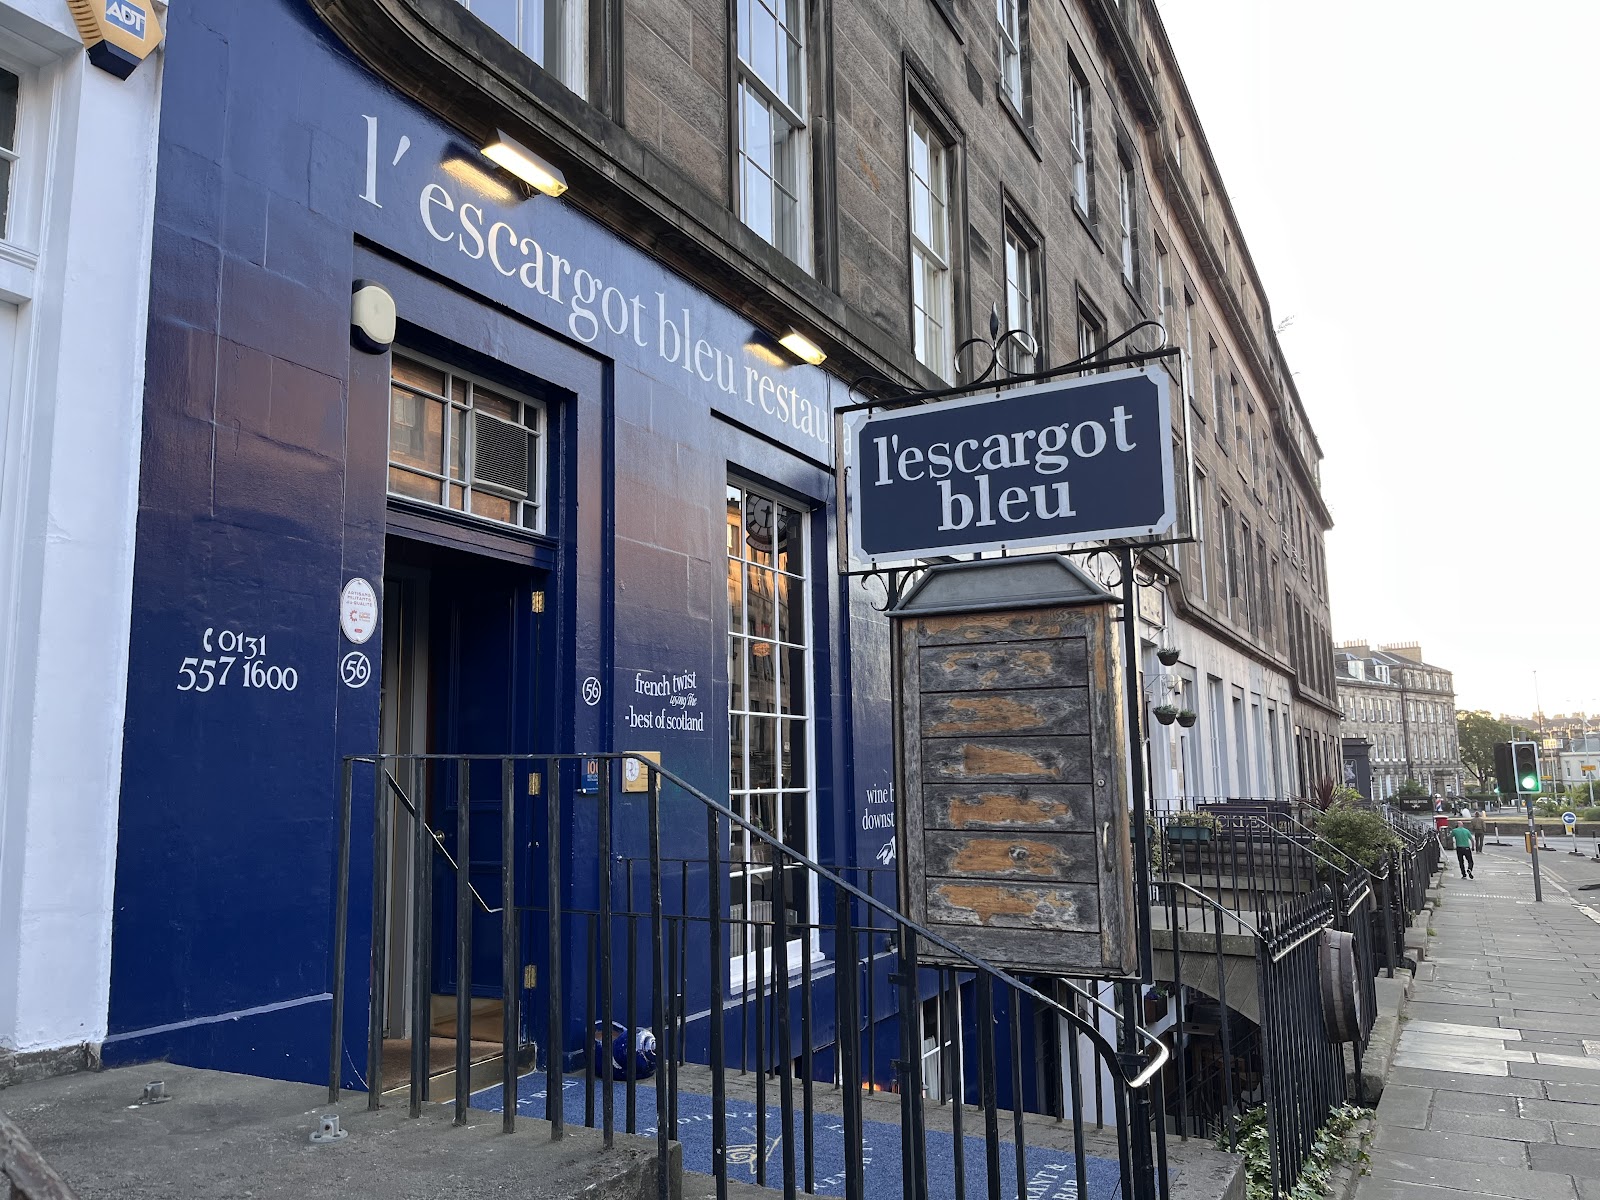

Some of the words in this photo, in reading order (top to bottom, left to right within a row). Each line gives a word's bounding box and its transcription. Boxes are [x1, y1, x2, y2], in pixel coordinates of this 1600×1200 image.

[106, 1, 145, 31] ADT
[655, 291, 737, 395] bleu
[873, 405, 1137, 486] l'escargot
[936, 474, 1077, 531] bleu
[218, 630, 266, 660] 0131
[176, 656, 236, 692] 557
[242, 660, 298, 691] 1600
[344, 654, 368, 684] 56
[635, 672, 671, 696] french
[672, 669, 697, 693] twist
[585, 680, 600, 702] 56
[655, 708, 666, 728] of
[666, 710, 704, 731] scotland
[866, 783, 888, 804] wine
[1044, 1163, 1067, 1171] &
